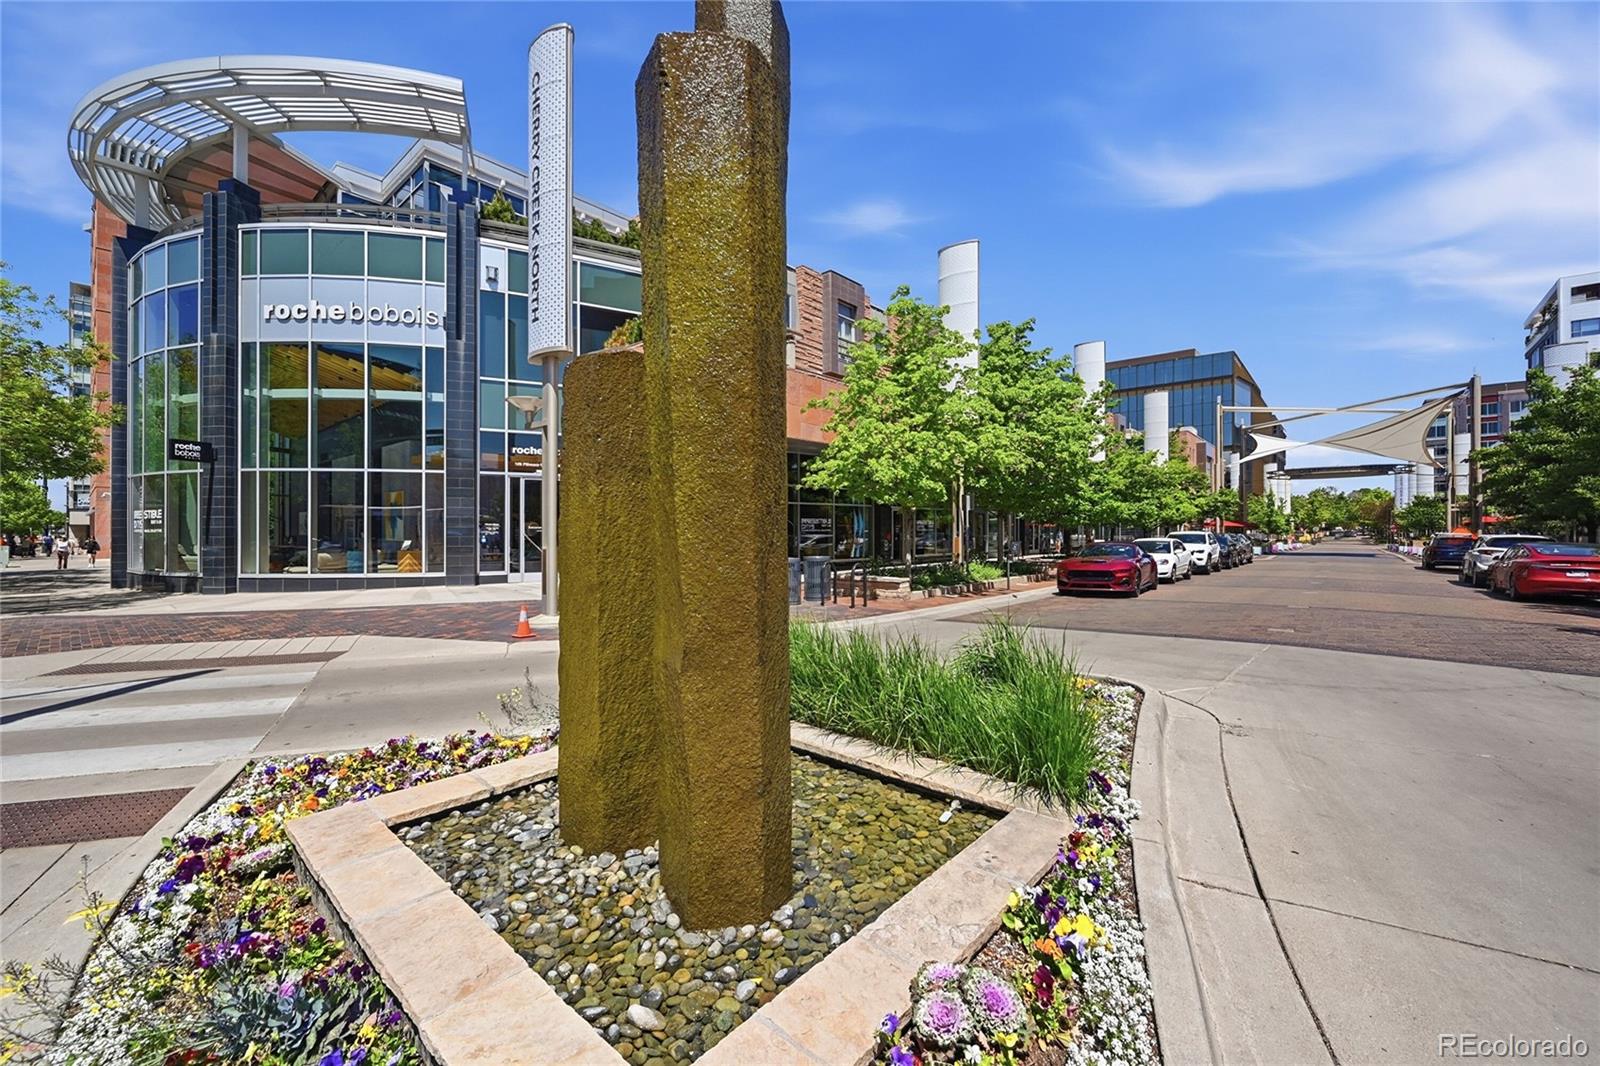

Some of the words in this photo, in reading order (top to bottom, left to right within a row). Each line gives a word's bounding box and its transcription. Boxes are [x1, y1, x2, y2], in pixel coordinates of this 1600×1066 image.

[532, 71, 540, 160] CHERRY
[532, 165, 540, 240] CREEK
[263, 299, 346, 320] roche
[350, 302, 439, 326] bobois
[531, 243, 540, 323] NORTH
[174, 443, 201, 451] roche
